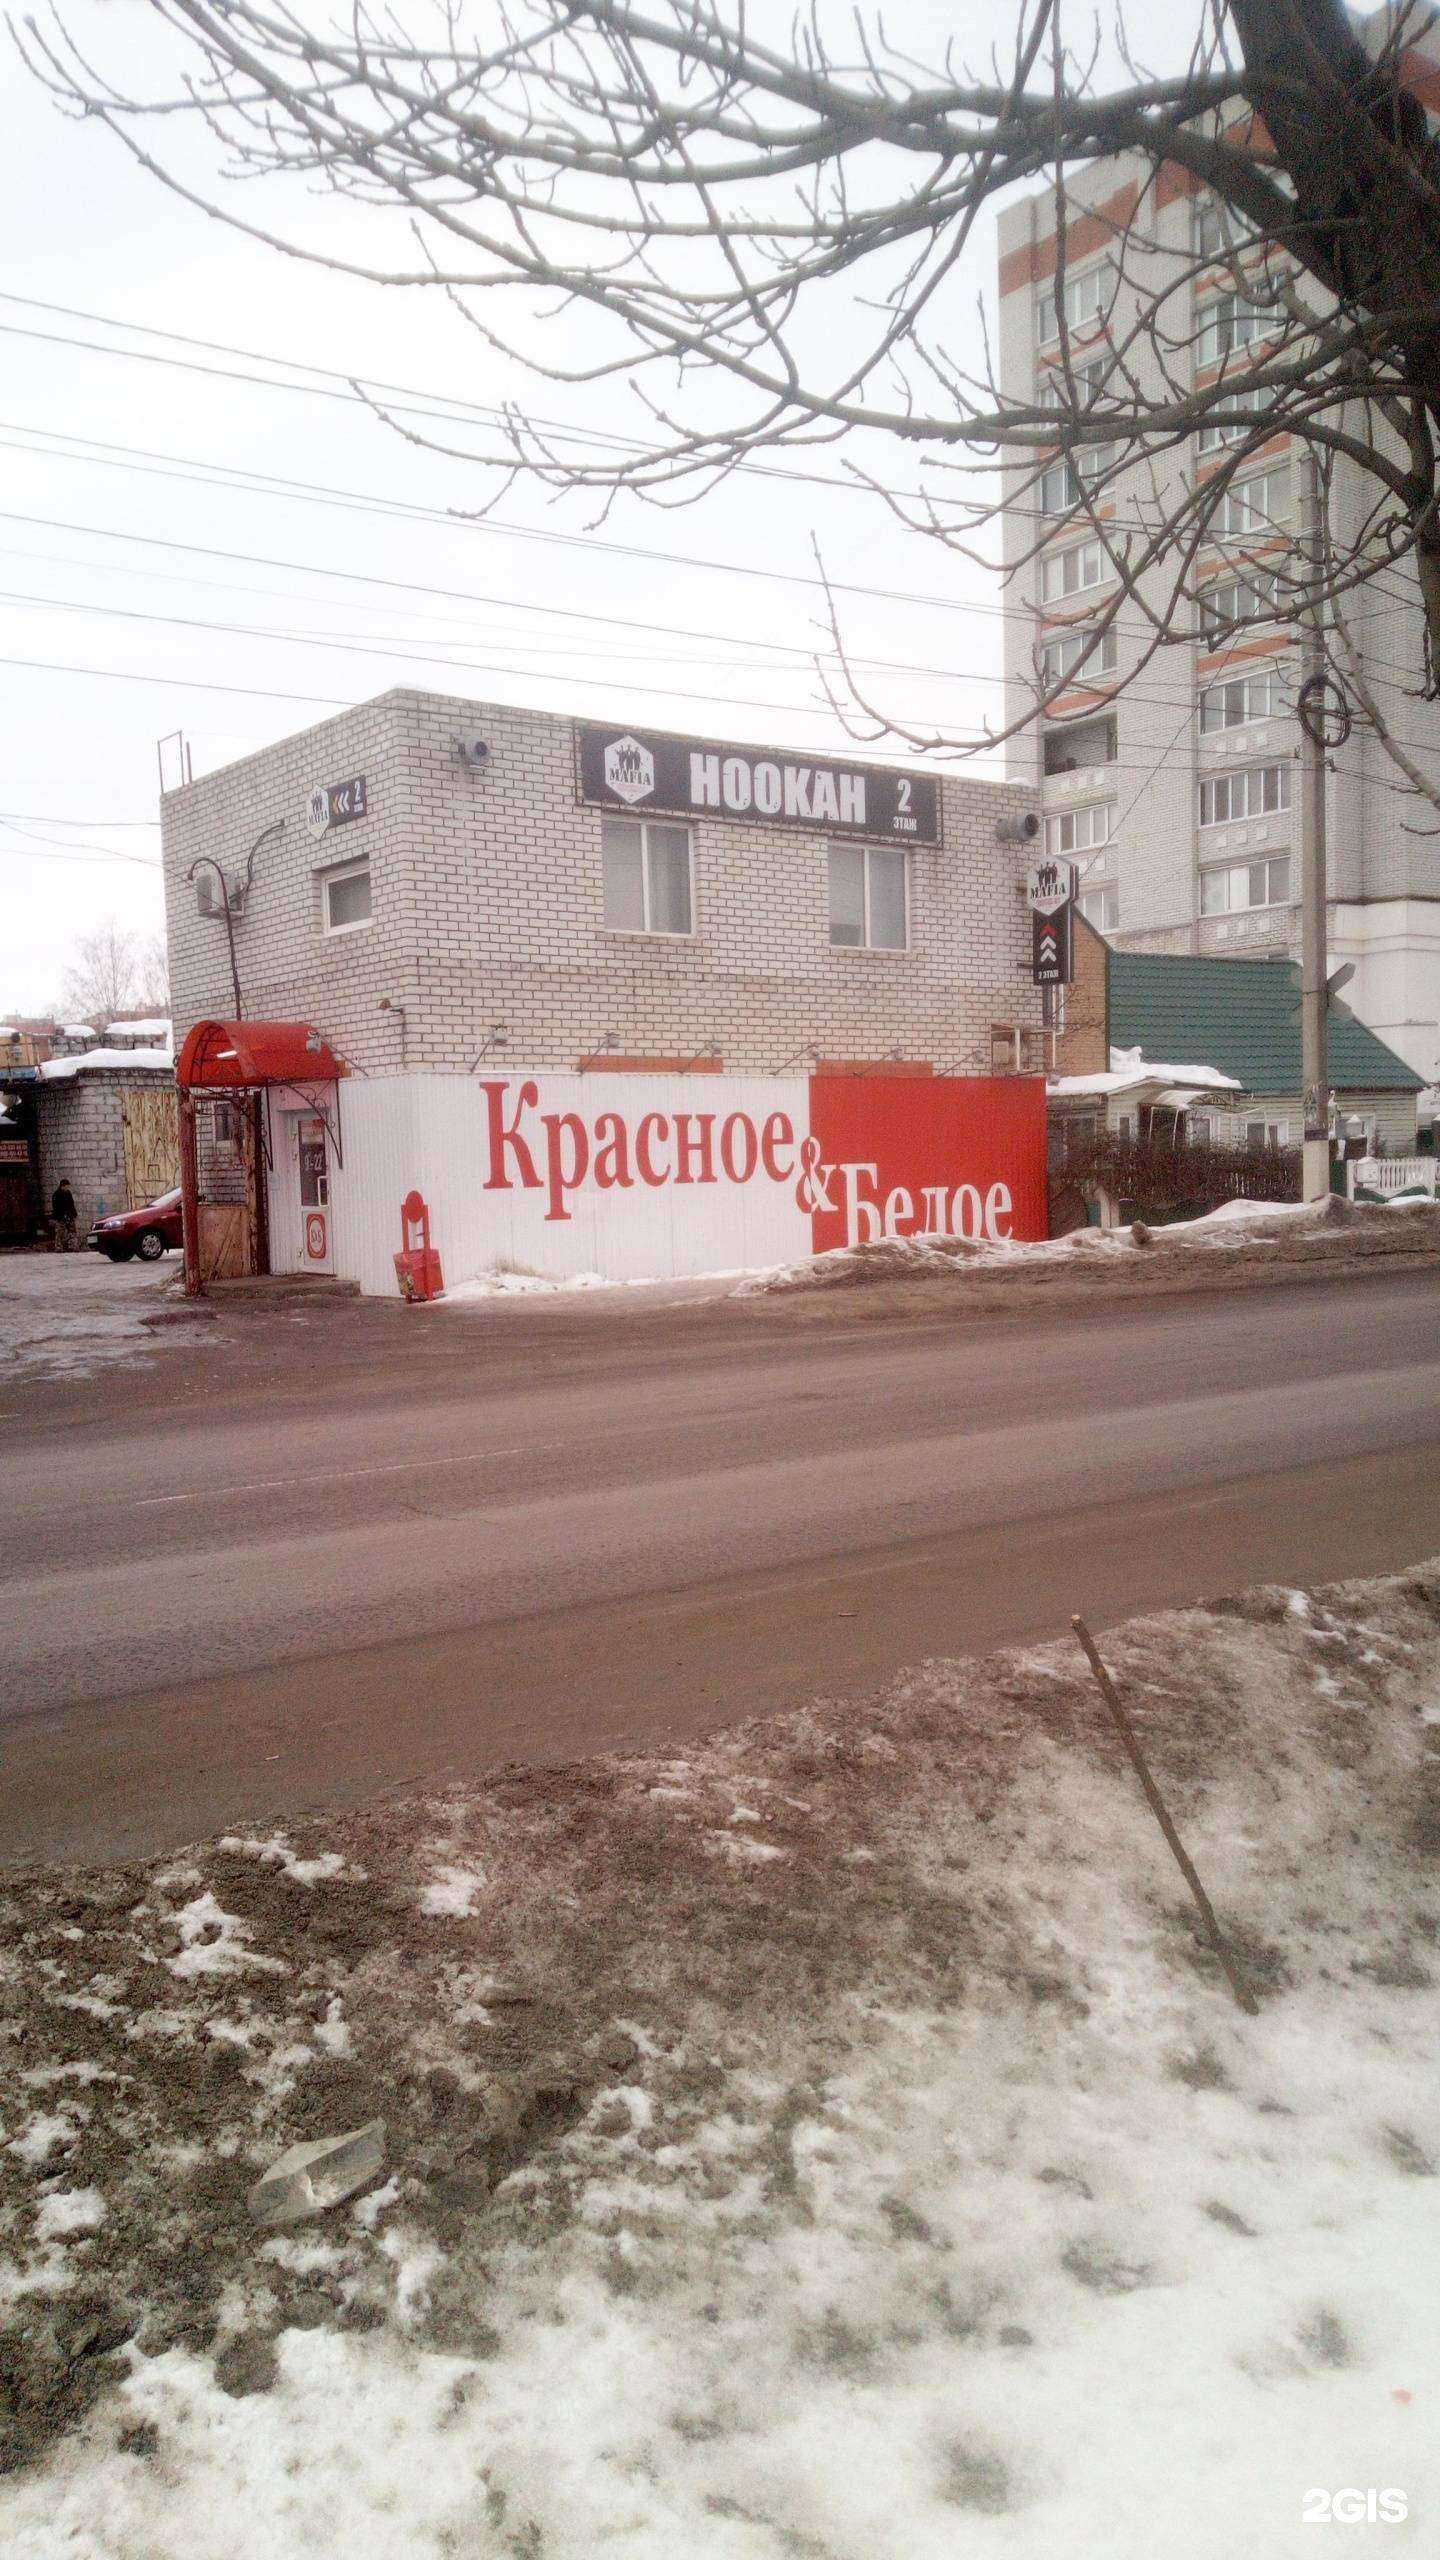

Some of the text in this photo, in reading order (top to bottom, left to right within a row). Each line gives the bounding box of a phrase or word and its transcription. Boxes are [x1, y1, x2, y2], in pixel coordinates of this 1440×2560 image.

[609, 768, 651, 786] MAFIA
[689, 752, 867, 824] HOOKAH
[355, 781, 361, 803] 2
[897, 779, 911, 812] 2
[893, 816, 917, 831] ЭТАЖ
[1030, 882, 1066, 899] MAFIA
[479, 1080, 795, 1221] Красное
[795, 1136, 1013, 1250] & Белое
